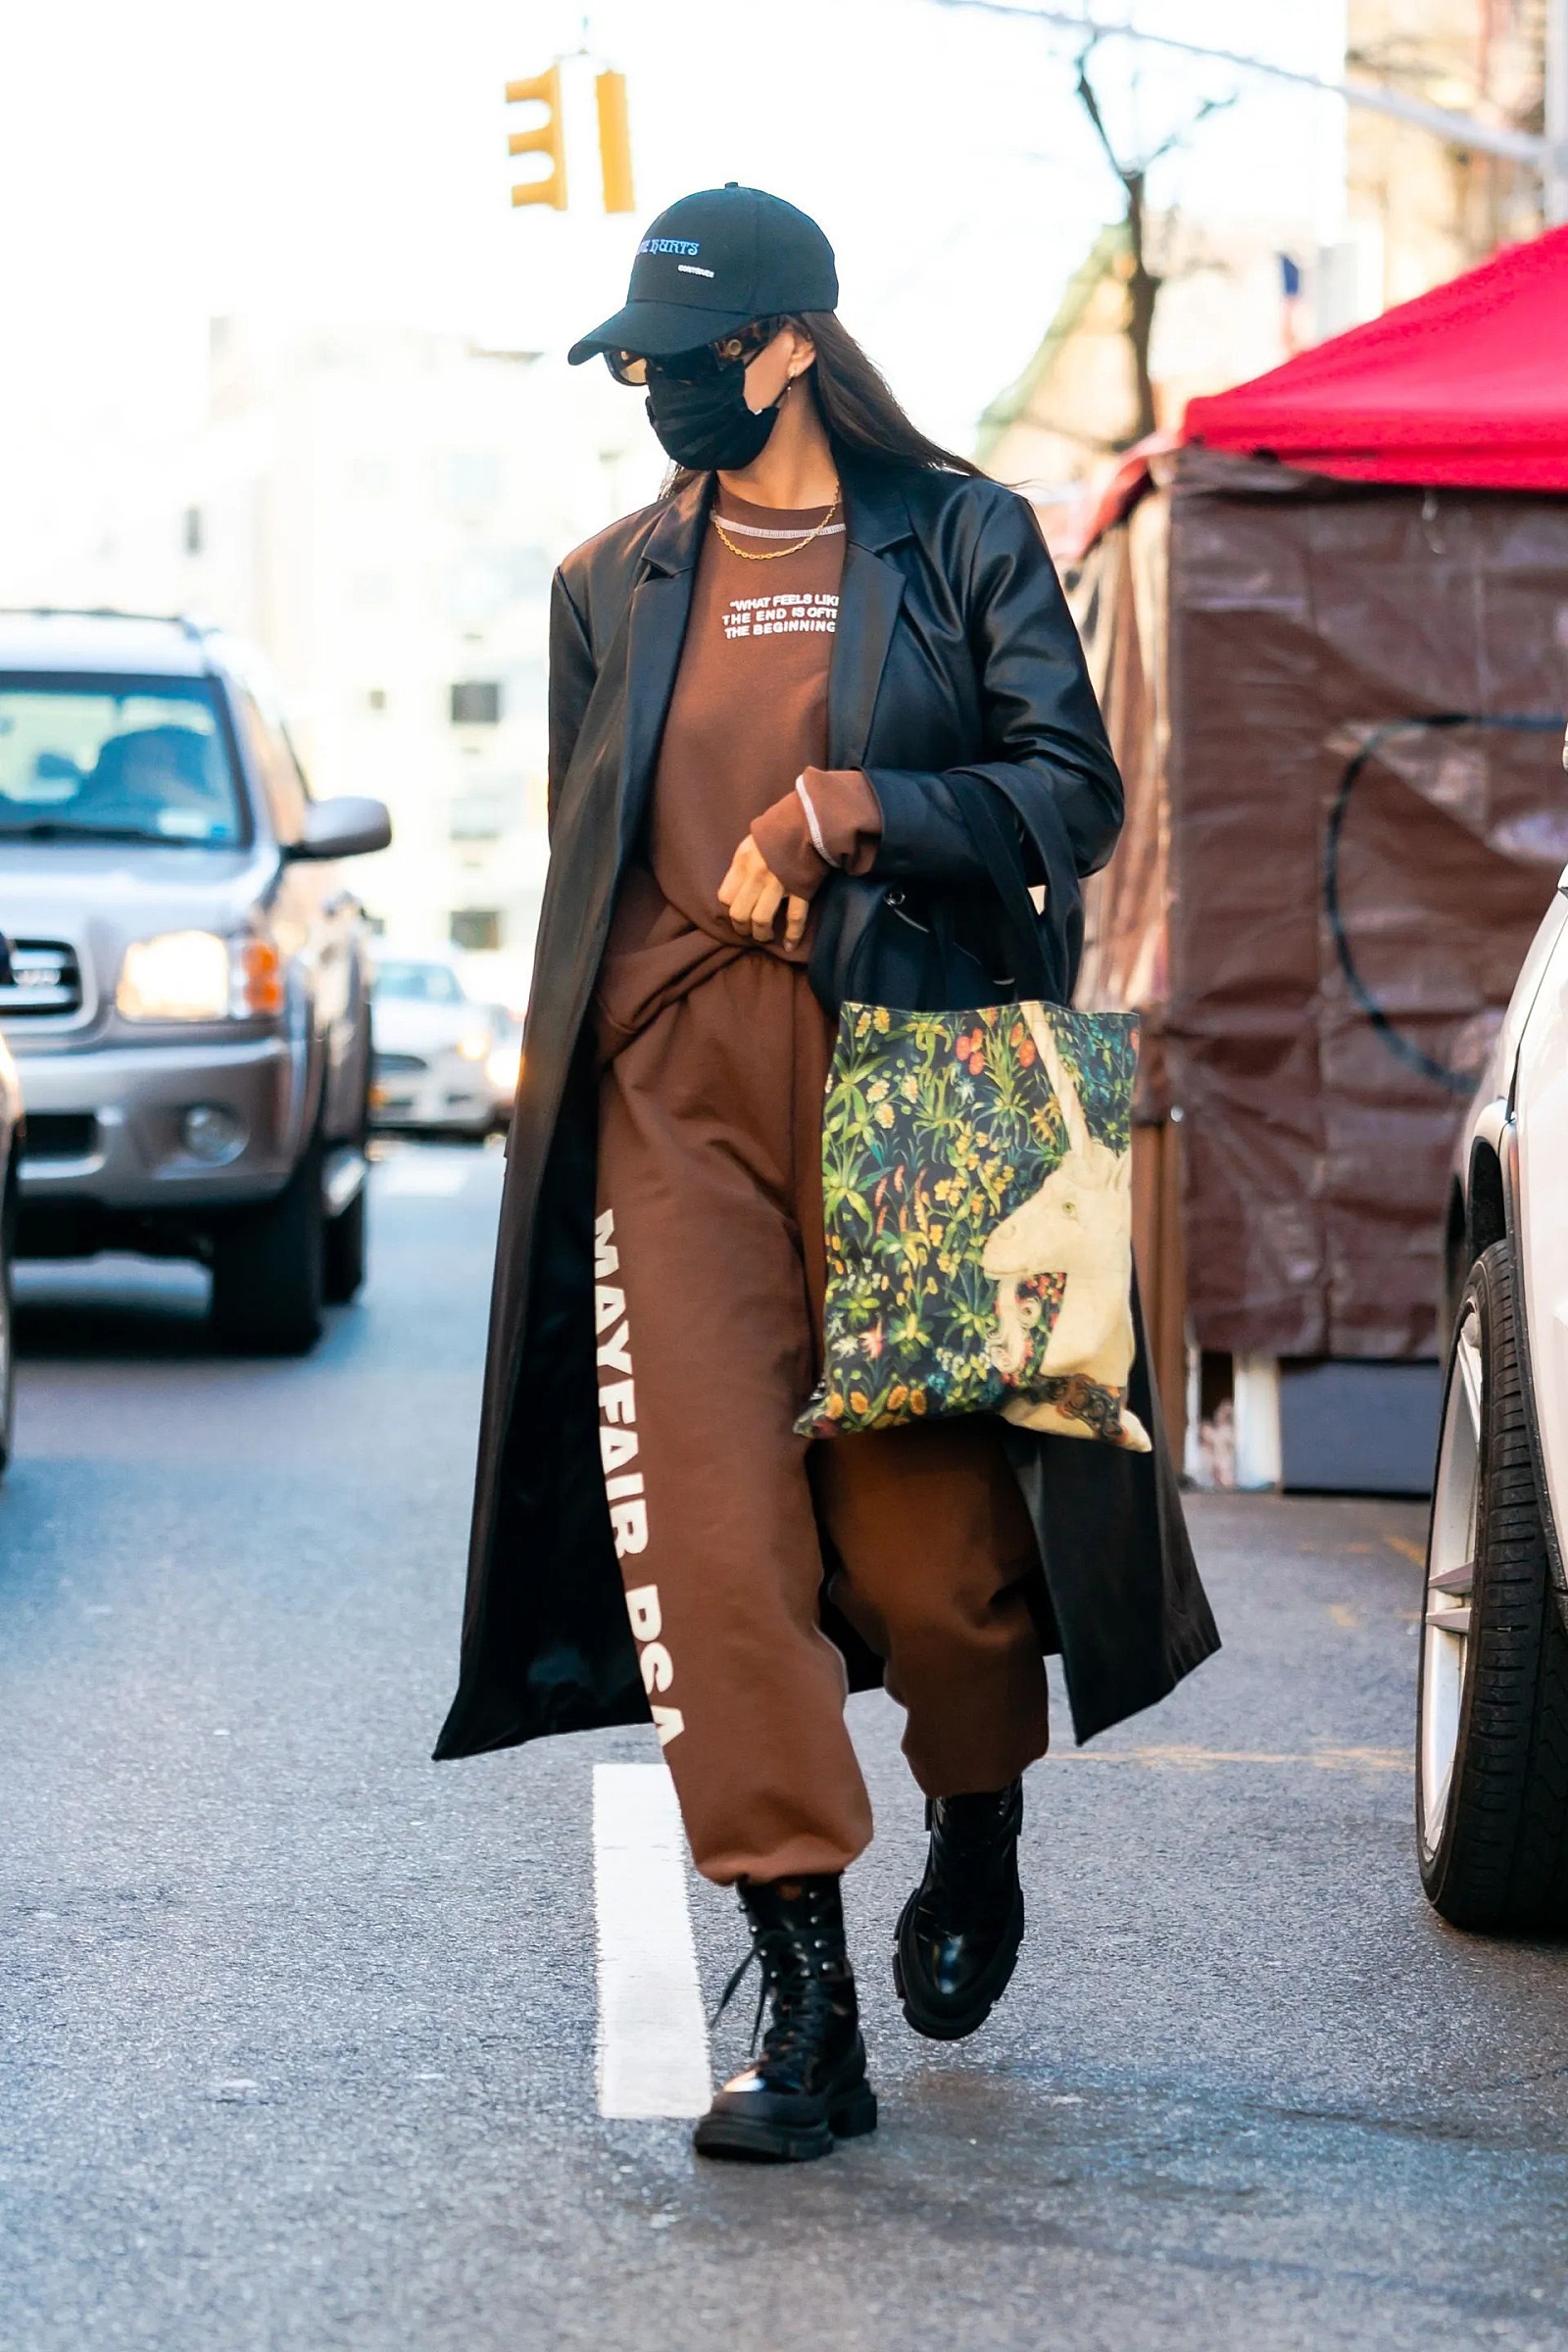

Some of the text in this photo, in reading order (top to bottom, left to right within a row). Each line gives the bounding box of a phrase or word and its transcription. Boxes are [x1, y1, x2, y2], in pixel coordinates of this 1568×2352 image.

[772, 594, 812, 607] FEELS
[722, 613, 751, 625] THE
[756, 609, 787, 621] END
[791, 607, 806, 618] IS
[724, 620, 836, 639] THE BEGINNING
[594, 1208, 649, 1559] MAYFAIR
